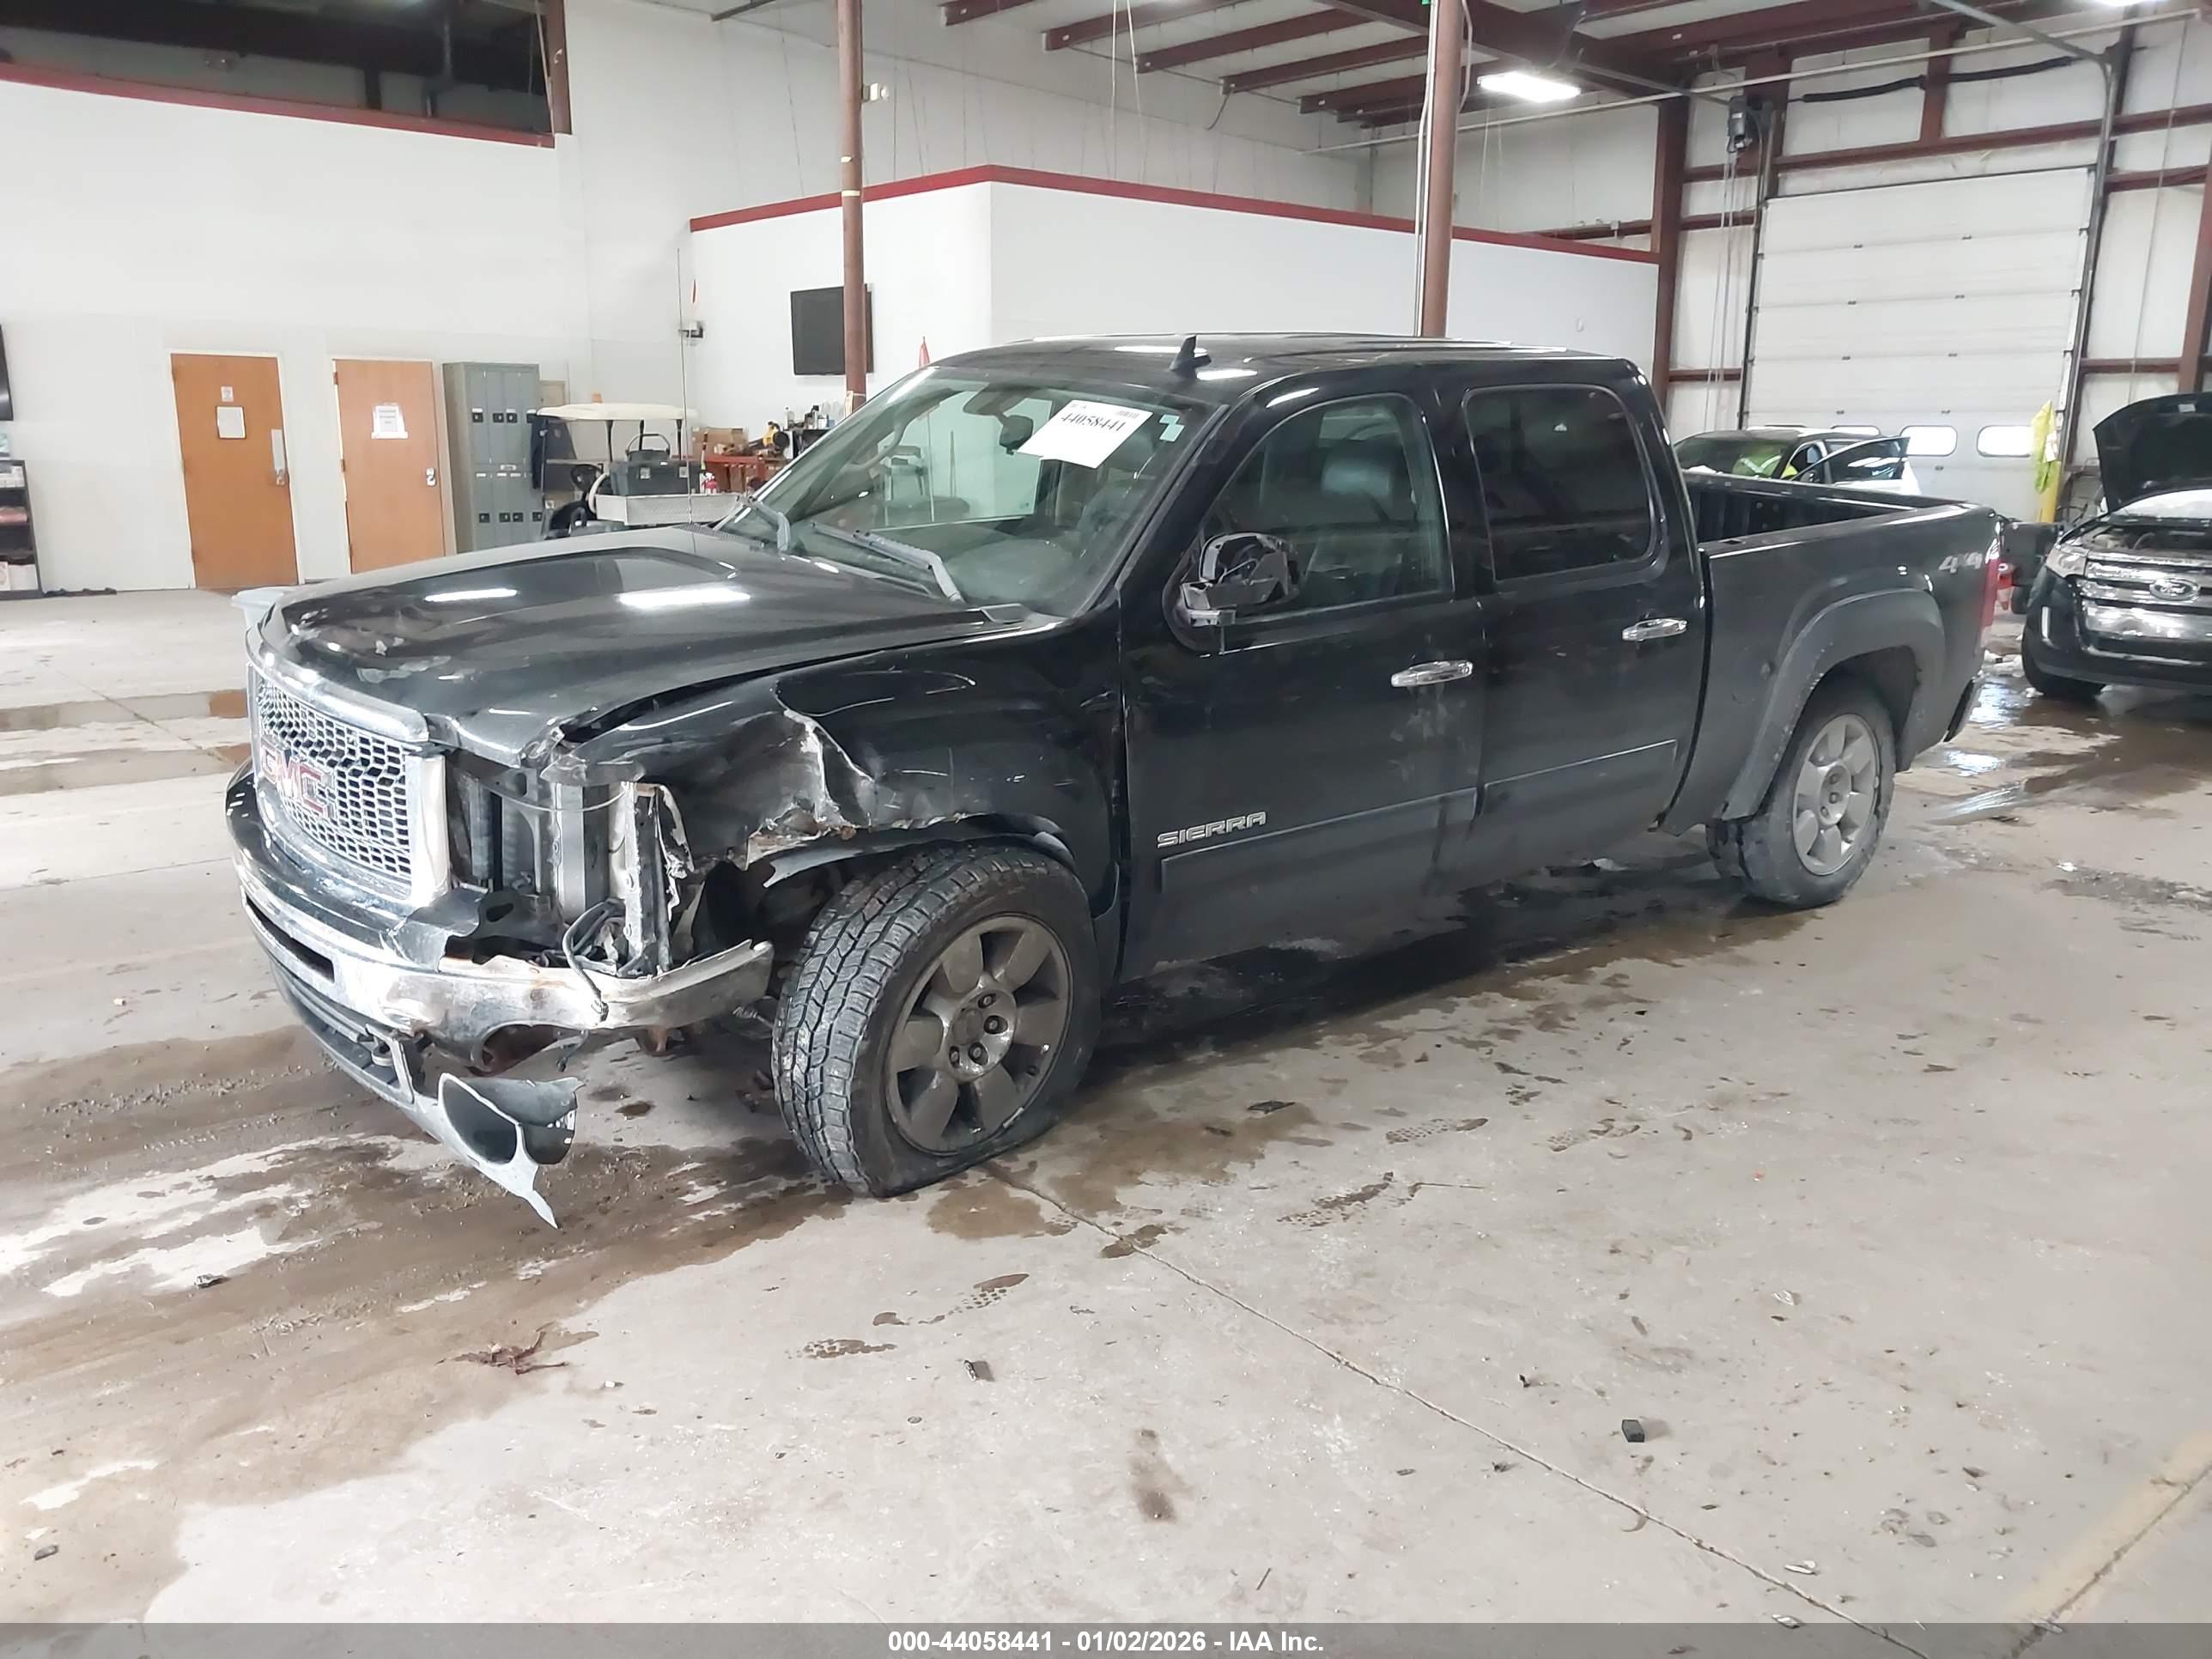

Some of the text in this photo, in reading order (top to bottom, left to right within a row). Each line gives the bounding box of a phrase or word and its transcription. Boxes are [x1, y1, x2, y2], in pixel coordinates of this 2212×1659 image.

[1060, 412, 1127, 431] 44058441
[260, 737, 331, 817] GMC
[1156, 811, 1267, 848] SIERRA
